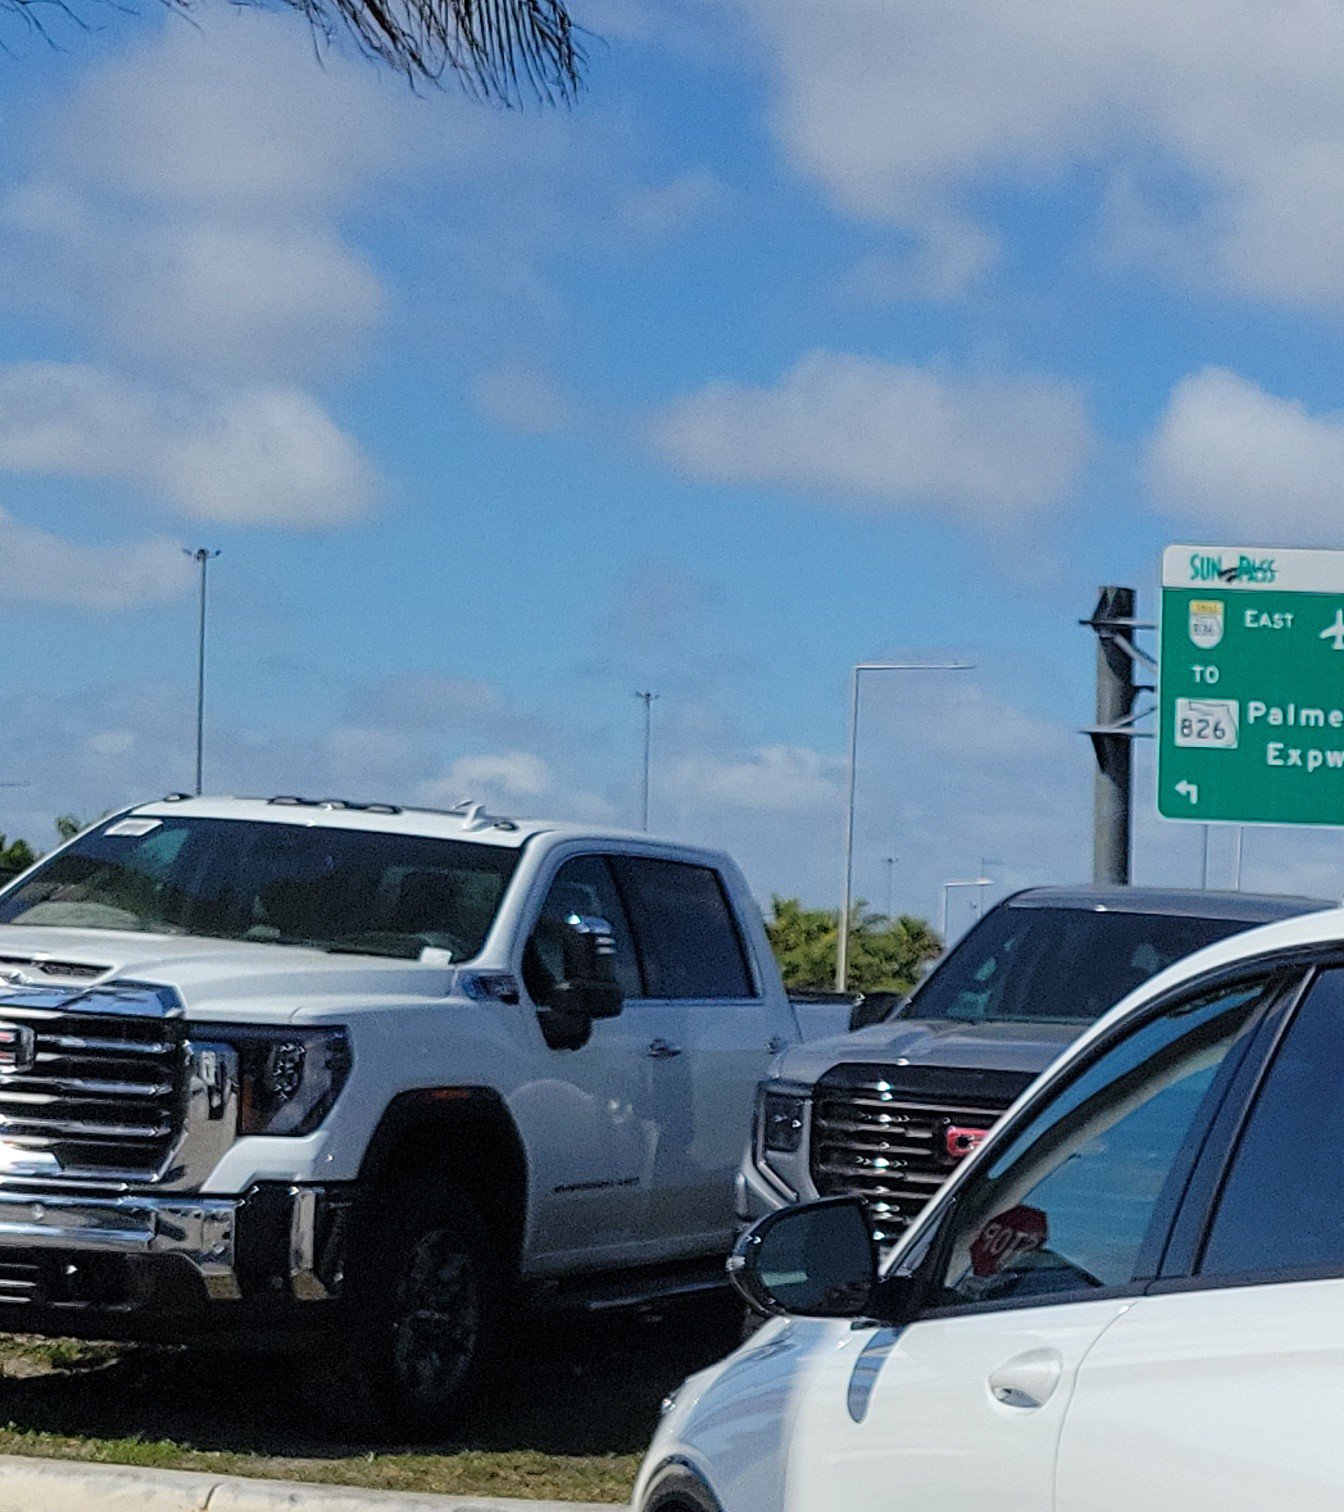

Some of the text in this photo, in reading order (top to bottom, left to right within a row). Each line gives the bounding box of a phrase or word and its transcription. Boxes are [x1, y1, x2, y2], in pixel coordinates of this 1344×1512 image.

[1244, 609, 1294, 630] EAST
[1190, 665, 1220, 684] TO
[1180, 718, 1226, 740] 826
